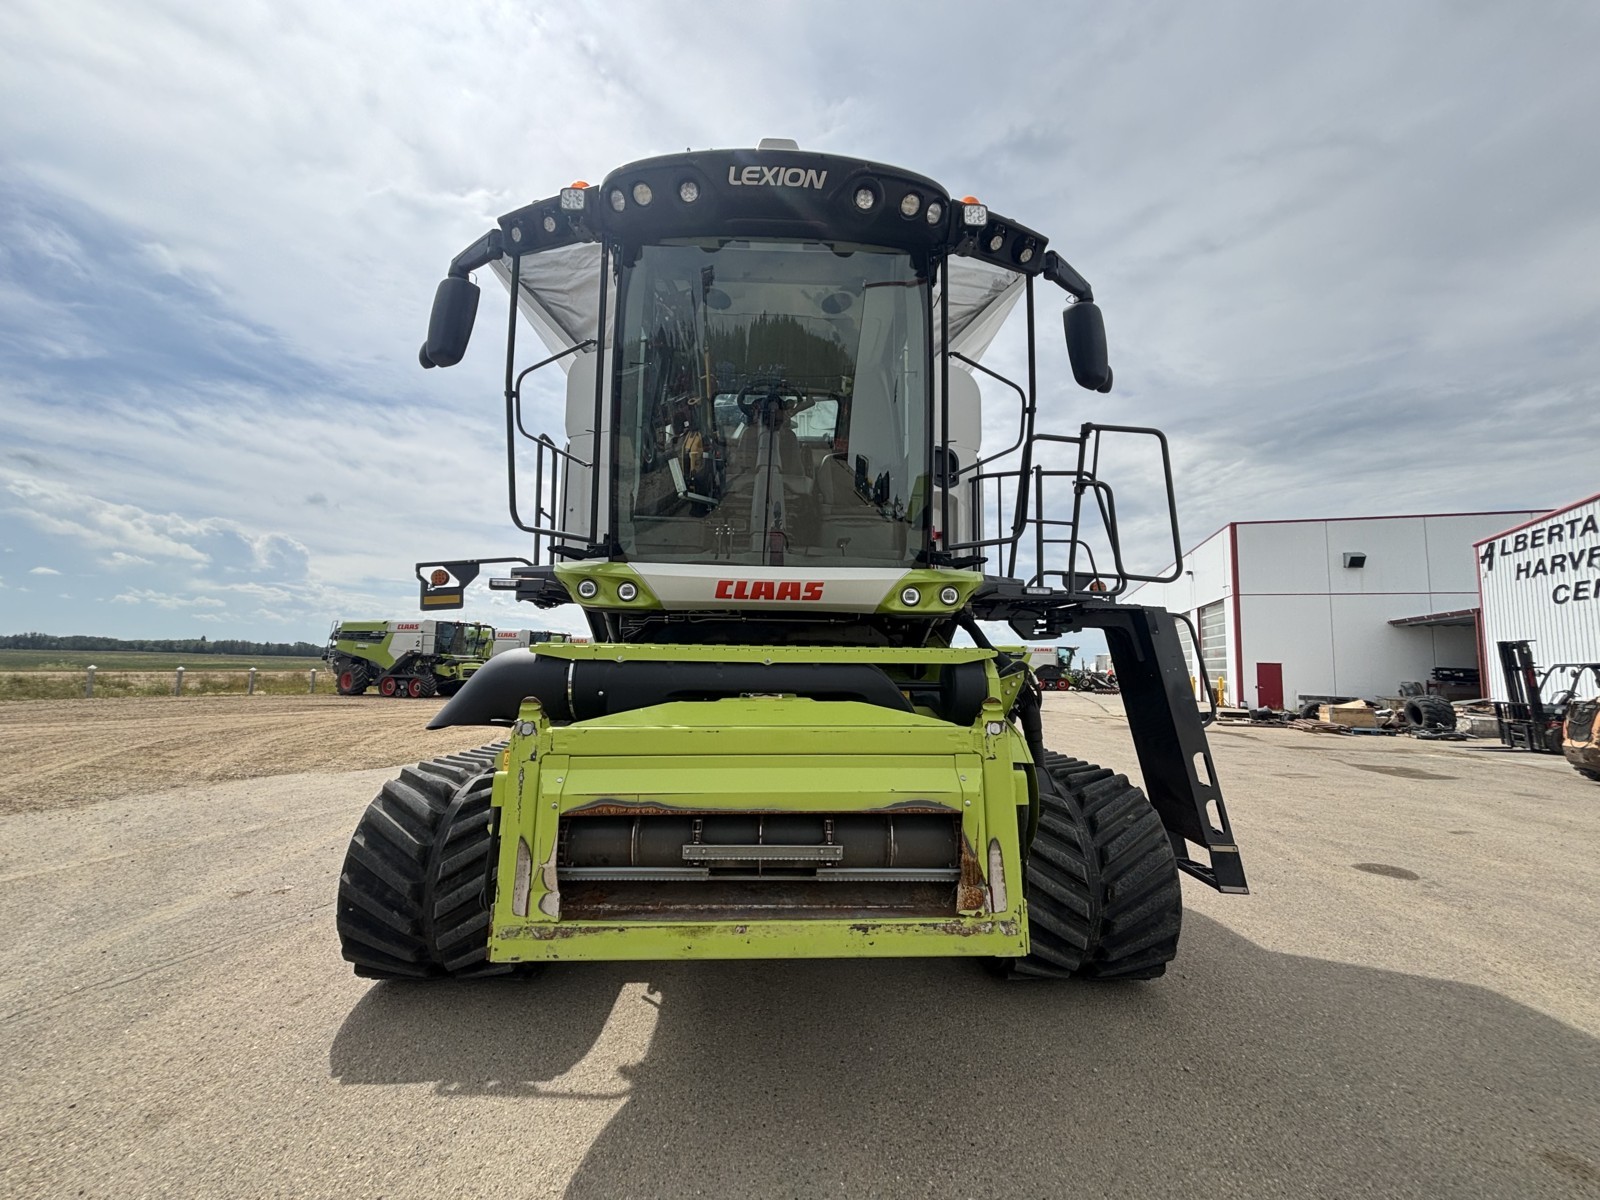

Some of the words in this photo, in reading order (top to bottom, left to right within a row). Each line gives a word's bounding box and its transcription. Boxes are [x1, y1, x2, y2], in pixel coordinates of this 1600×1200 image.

[728, 166, 828, 190] LEXION
[1480, 514, 1599, 571] ALBERTA
[714, 580, 825, 601] CLAAS
